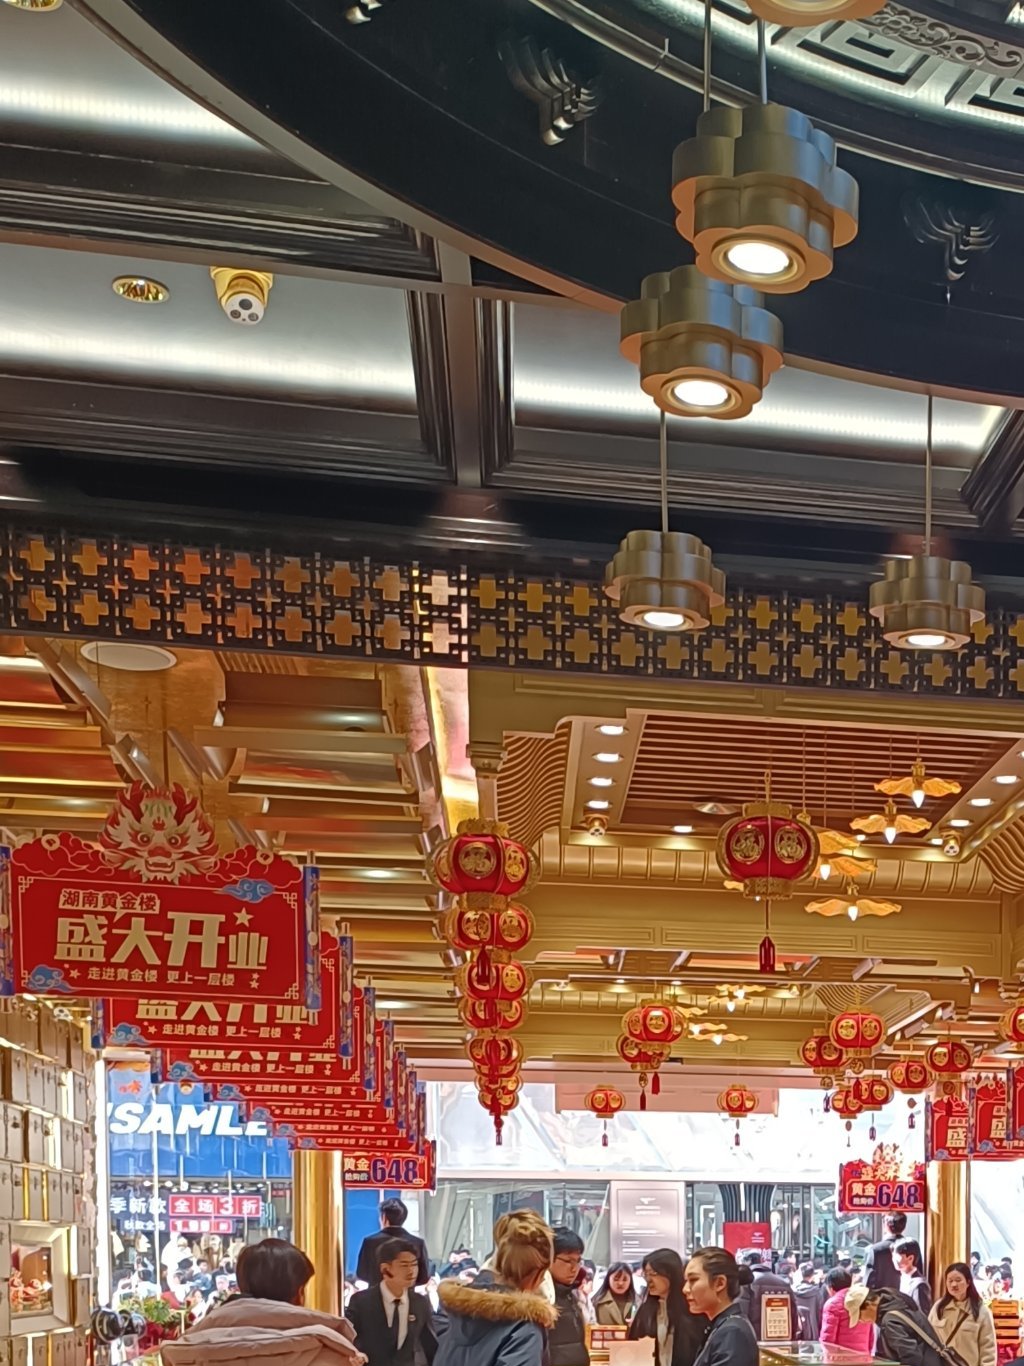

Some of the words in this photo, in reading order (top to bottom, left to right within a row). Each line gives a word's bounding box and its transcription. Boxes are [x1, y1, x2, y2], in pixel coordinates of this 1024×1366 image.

[61, 889, 158, 912] 湖南黄金楼
[54, 912, 269, 970] 盛大开业
[87, 967, 158, 983] 走进黄金楼
[162, 1024, 219, 1037] 走进黄金楼
[371, 1158, 419, 1184] 648
[878, 1184, 919, 1207] 648
